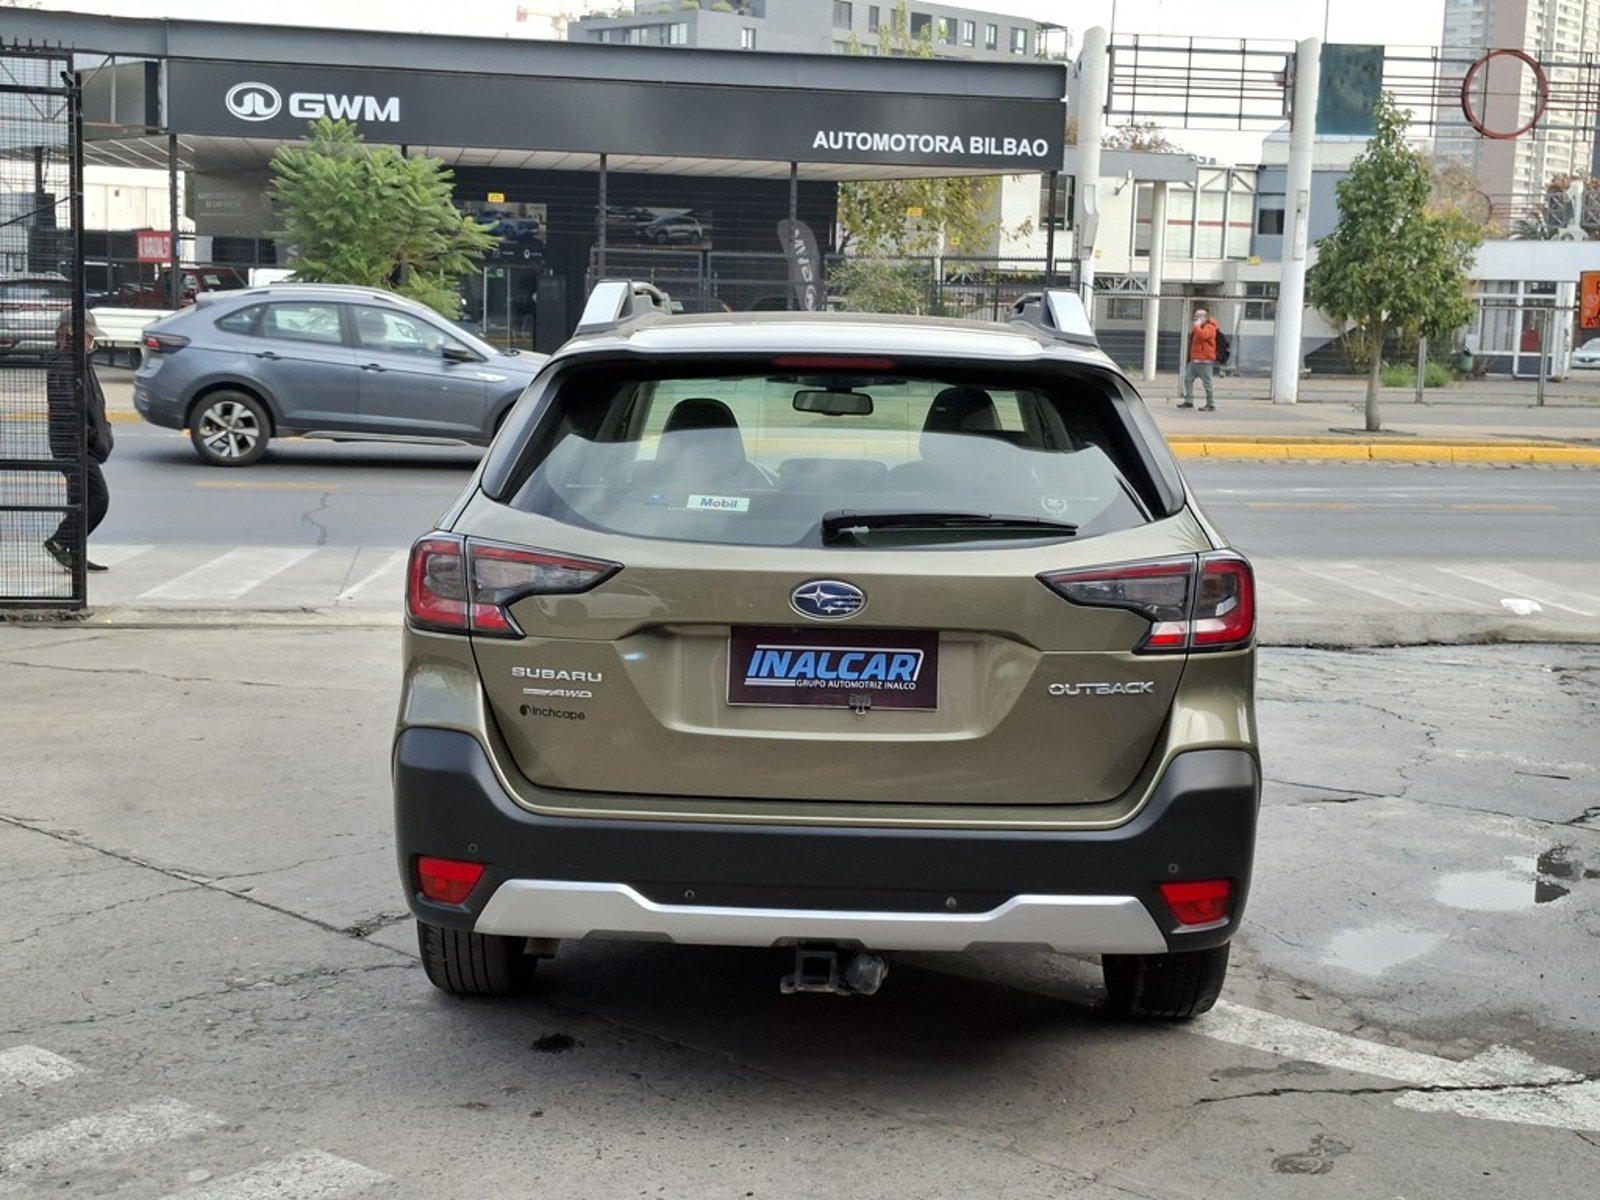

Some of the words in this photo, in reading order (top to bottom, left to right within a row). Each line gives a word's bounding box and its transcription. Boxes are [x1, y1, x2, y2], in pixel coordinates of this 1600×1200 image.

[288, 92, 400, 123] GWM
[812, 130, 965, 154] AUTOMOTORA
[969, 136, 1049, 157] BILBAO
[700, 498, 738, 509] Mobil
[746, 649, 917, 681] INALCAR
[511, 666, 603, 682] SUBARU
[796, 679, 826, 689] GRUPO
[827, 680, 883, 690] AUTOMOTRIZ
[884, 681, 917, 691] INALCO
[1048, 681, 1154, 695] OUTBACK
[532, 706, 586, 721] Inchcape
